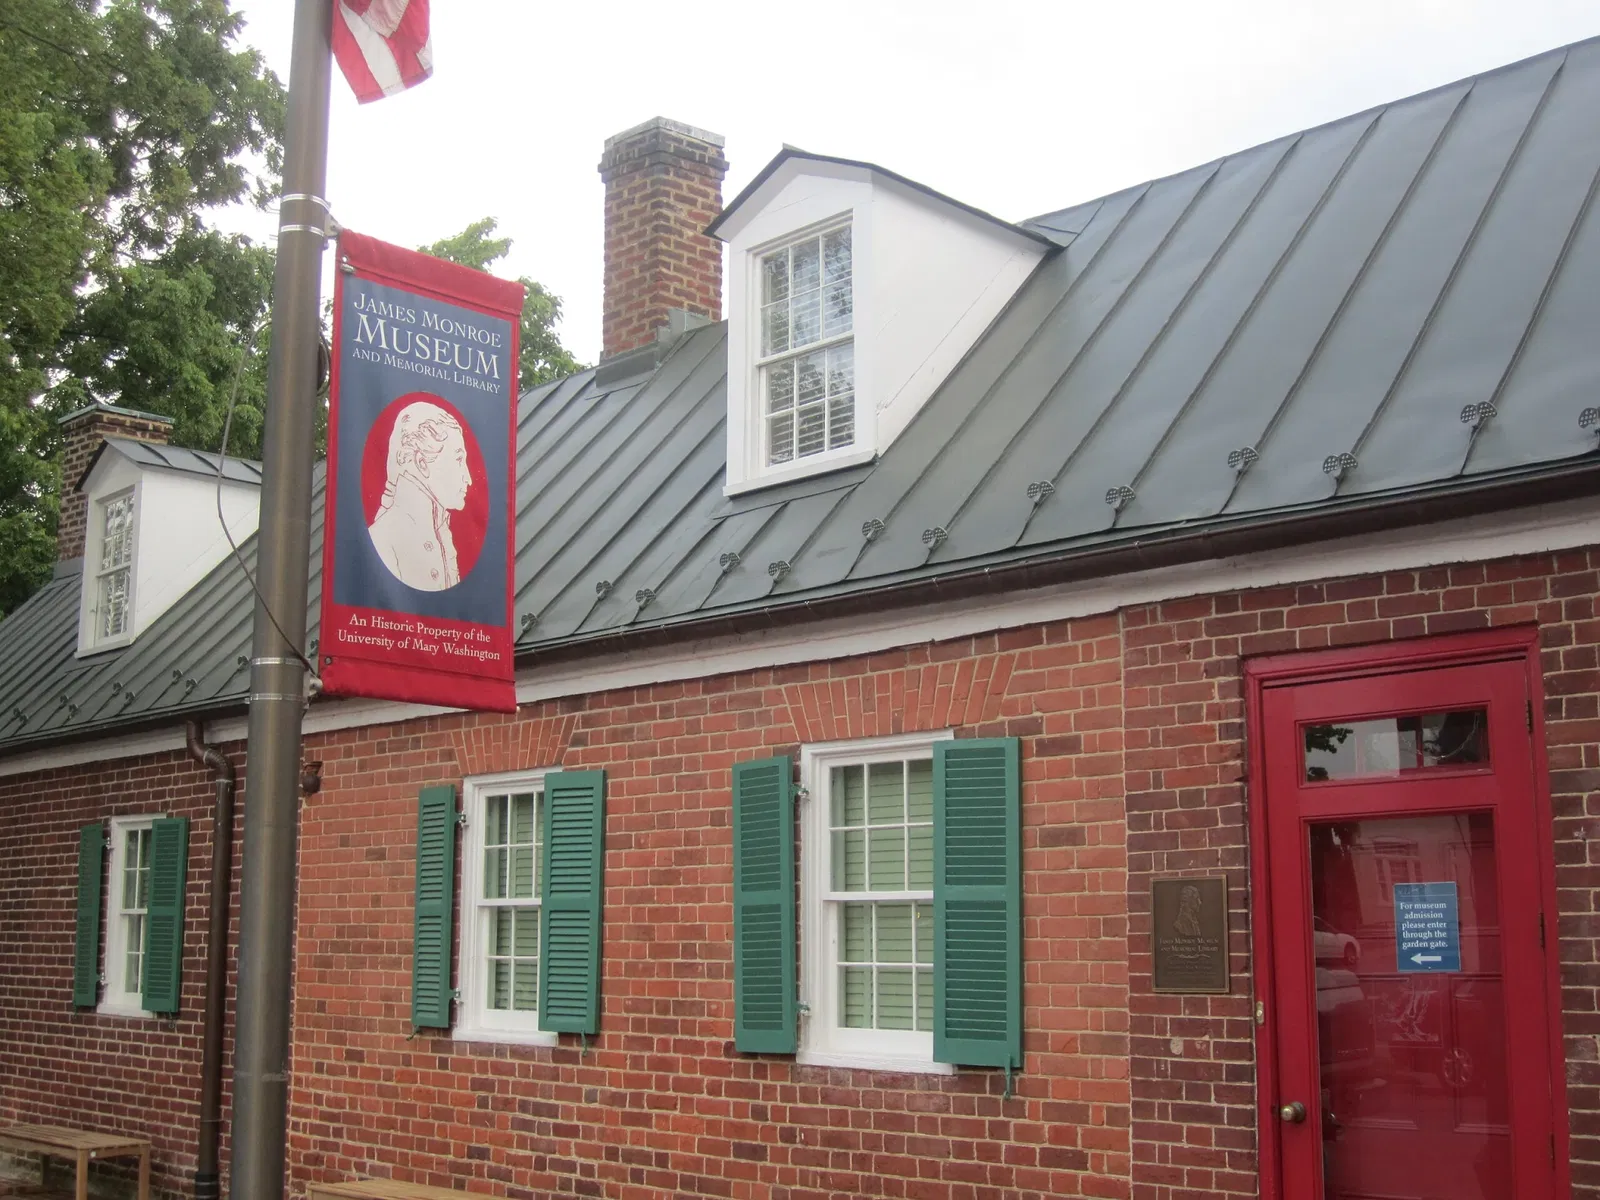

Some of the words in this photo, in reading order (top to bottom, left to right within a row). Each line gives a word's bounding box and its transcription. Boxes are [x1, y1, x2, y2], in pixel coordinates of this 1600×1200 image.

[353, 293, 416, 324] JAMES
[421, 310, 502, 348] MONROE
[353, 312, 501, 380] MUSEUM
[352, 348, 381, 363] AND
[384, 353, 450, 381] MEMORIAL
[454, 371, 500, 394] LIBRARY
[349, 613, 367, 627] An
[371, 616, 414, 633] Historic
[417, 622, 462, 641] Property
[463, 629, 476, 640] of
[476, 631, 491, 643] the
[338, 629, 394, 650] University
[397, 637, 411, 649] of
[412, 638, 439, 656] Mary
[442, 642, 500, 661] Washington
[1400, 902, 1413, 910] For
[1404, 911, 1443, 919] admission
[1402, 921, 1425, 930] please
[1402, 930, 1432, 940] through
[1434, 930, 1447, 938] the
[1402, 940, 1428, 950] garden
[1430, 940, 1448, 949] gate.
